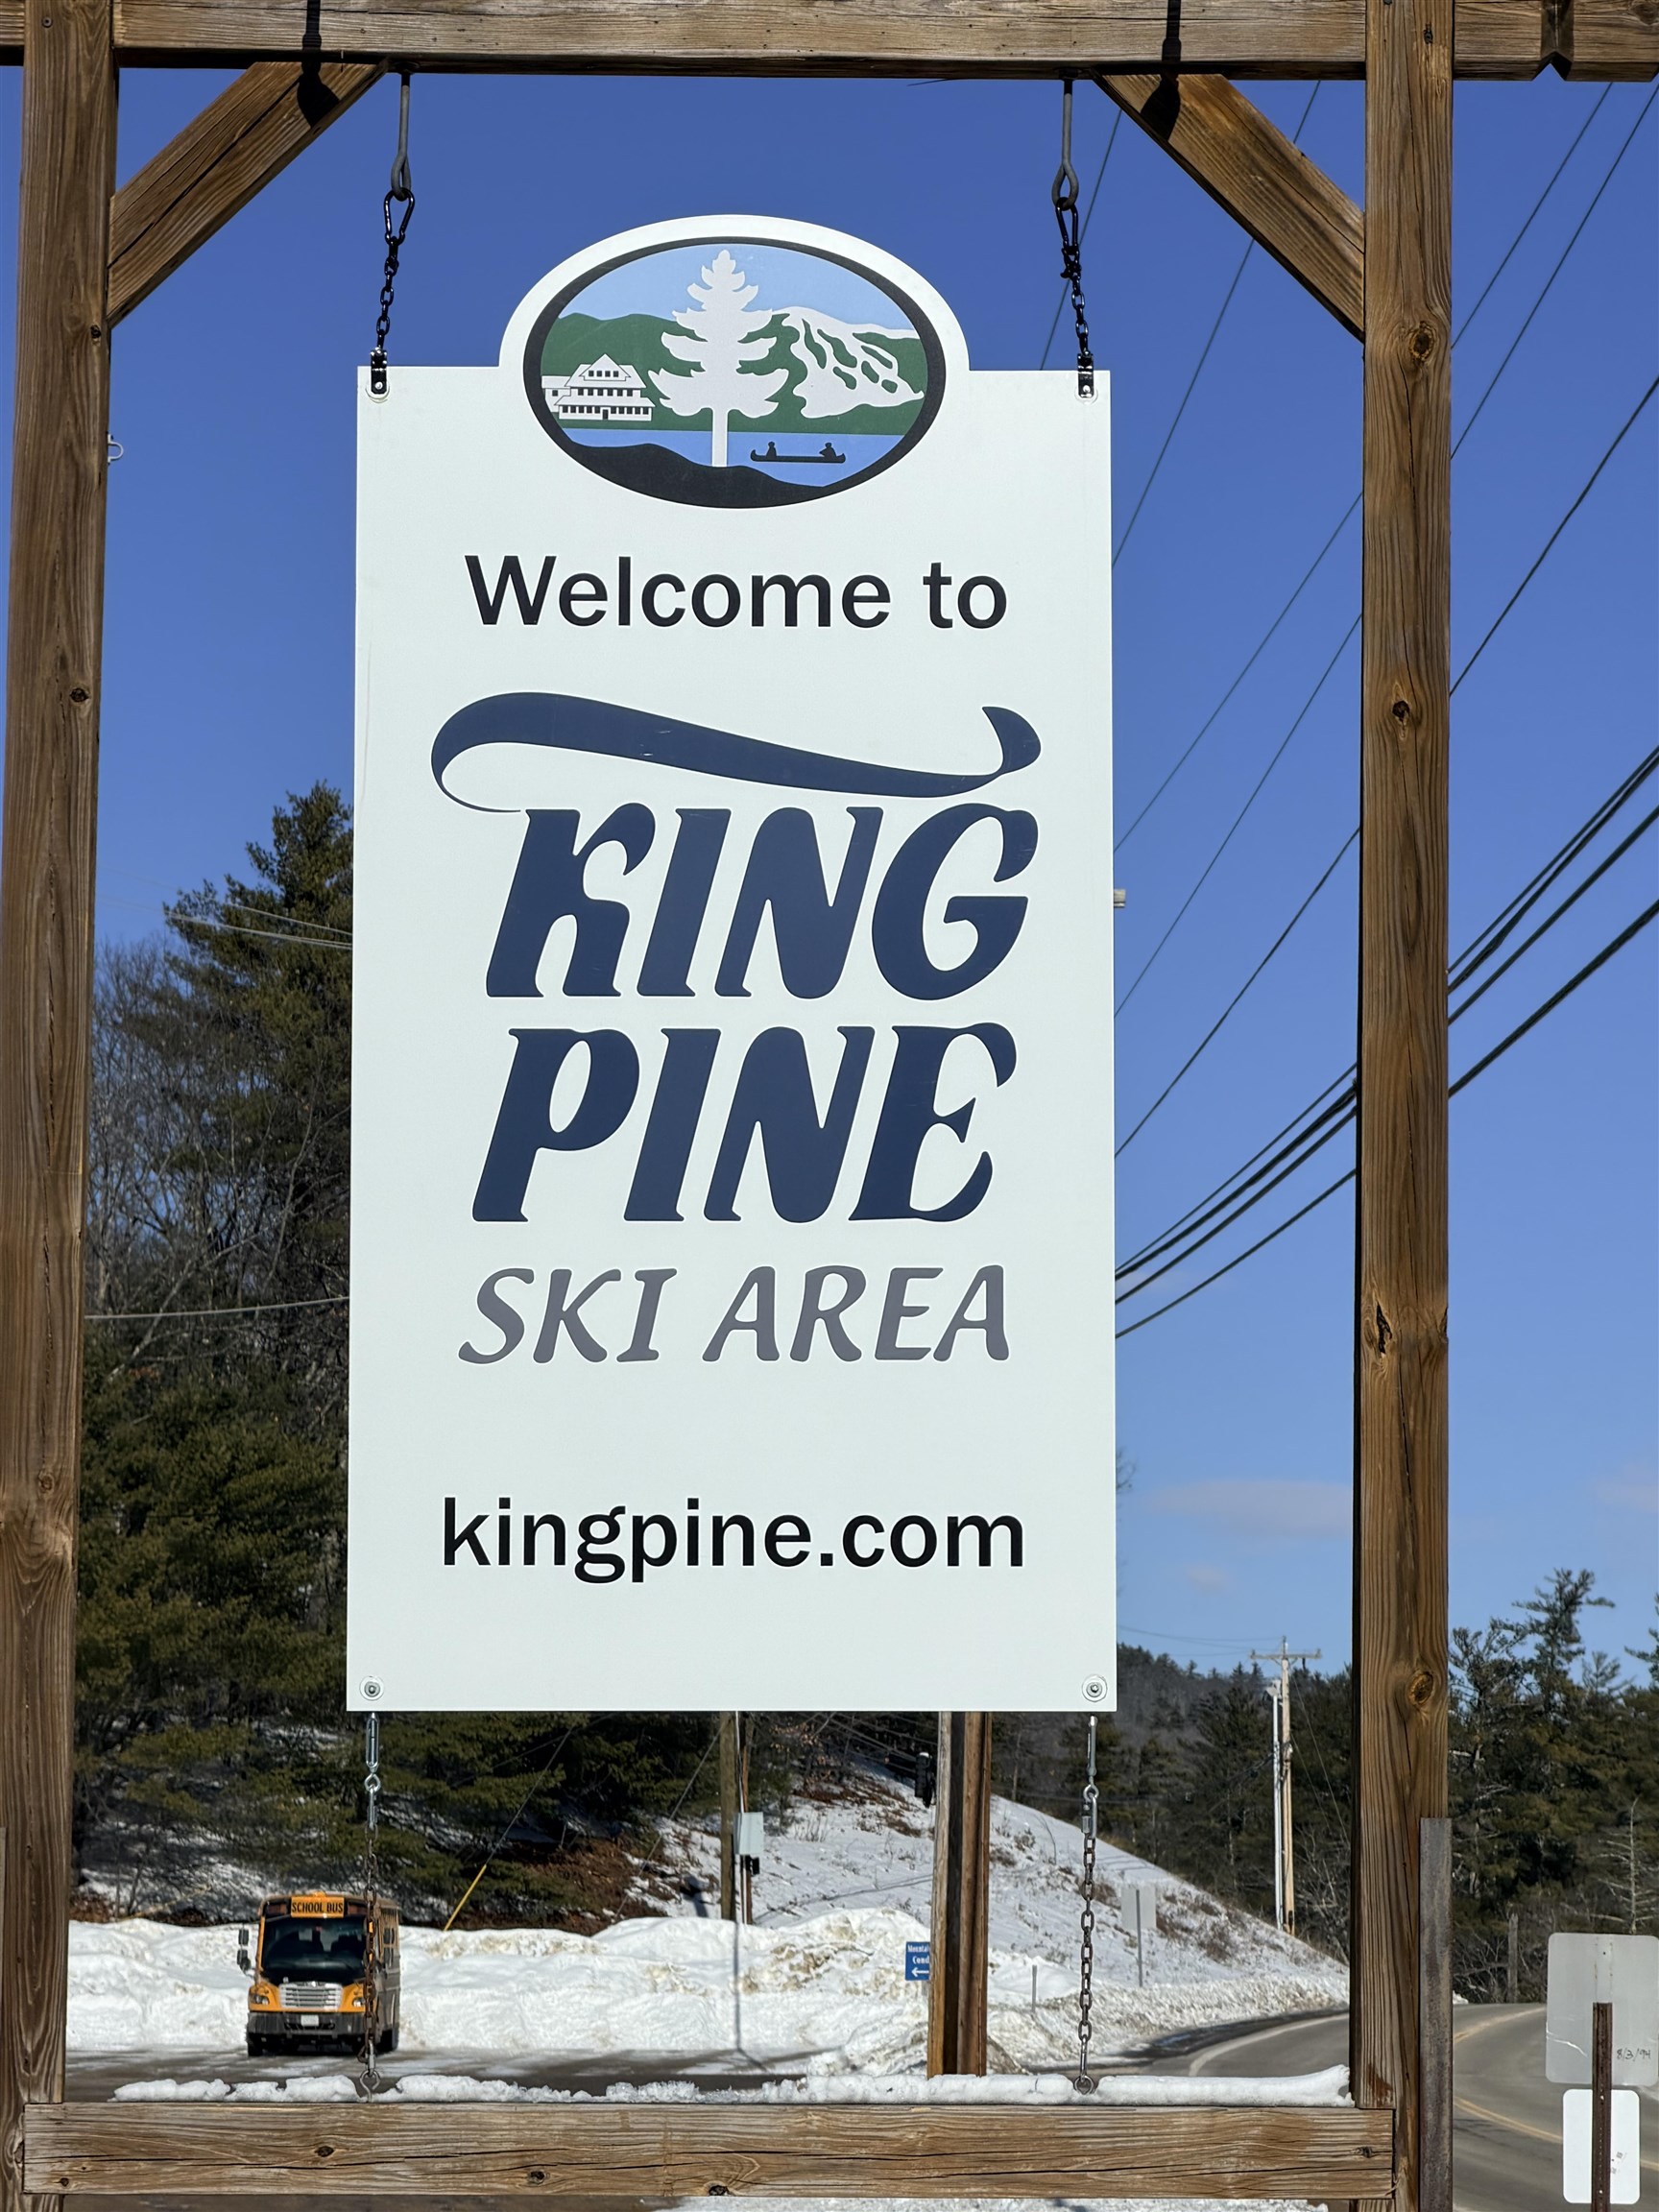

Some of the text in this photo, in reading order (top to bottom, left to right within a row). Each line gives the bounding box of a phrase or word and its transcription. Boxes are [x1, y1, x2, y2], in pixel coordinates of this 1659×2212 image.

[464, 555, 1007, 630] Welcome to
[485, 802, 1040, 1001] KING
[471, 1022, 1017, 1224] PINE
[458, 1264, 1010, 1365] SKI AREA
[444, 1497, 1023, 1584] kingpine.com
[292, 1902, 343, 1913] SCHOOL BUS
[912, 1955, 929, 1964] Cond
